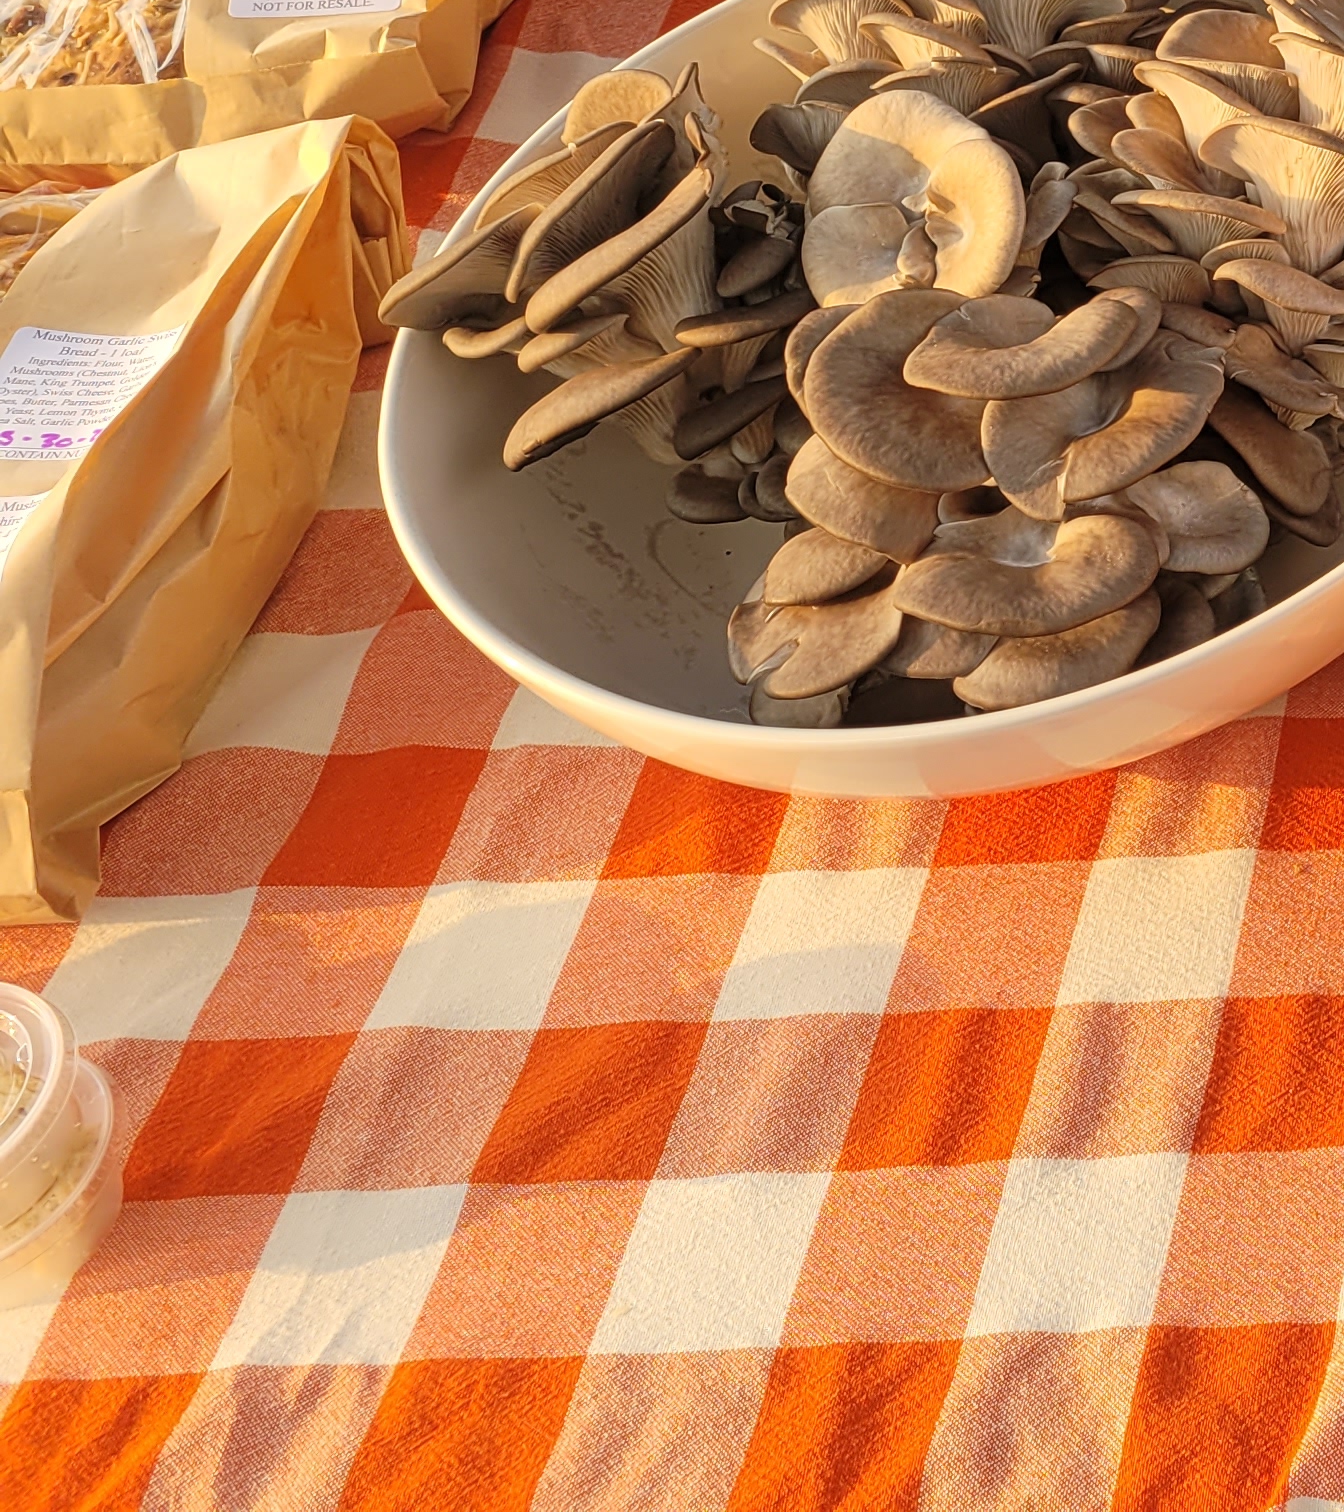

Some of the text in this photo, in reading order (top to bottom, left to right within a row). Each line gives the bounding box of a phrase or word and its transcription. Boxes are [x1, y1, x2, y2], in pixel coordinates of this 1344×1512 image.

[251, 1, 284, 12] NOT
[285, 0, 314, 11] FOR
[32, 329, 104, 345] Mushroom
[107, 336, 145, 346] Garlic
[58, 346, 99, 357] Bread
[109, 349, 118, 358] 1
[120, 346, 148, 357] loaf
[28, 356, 92, 367] Ingredients:
[94, 360, 124, 368] Flour,
[9, 365, 74, 376] Mushrooms
[76, 369, 128, 378] (Chestnut,
[3, 376, 37, 386] Mane,
[40, 378, 68, 388] King
[71, 379, 116, 388] Trumpet,
[41, 388, 74, 396] Swiss
[76, 389, 115, 397] Cheese,
[21, 397, 57, 406] Butter,
[60, 398, 111, 406] Parmesan
[5, 407, 35, 416] Yeast,
[38, 408, 77, 416] Lemon
[12, 418, 36, 426] Salt,
[40, 418, 75, 426] Garlic
